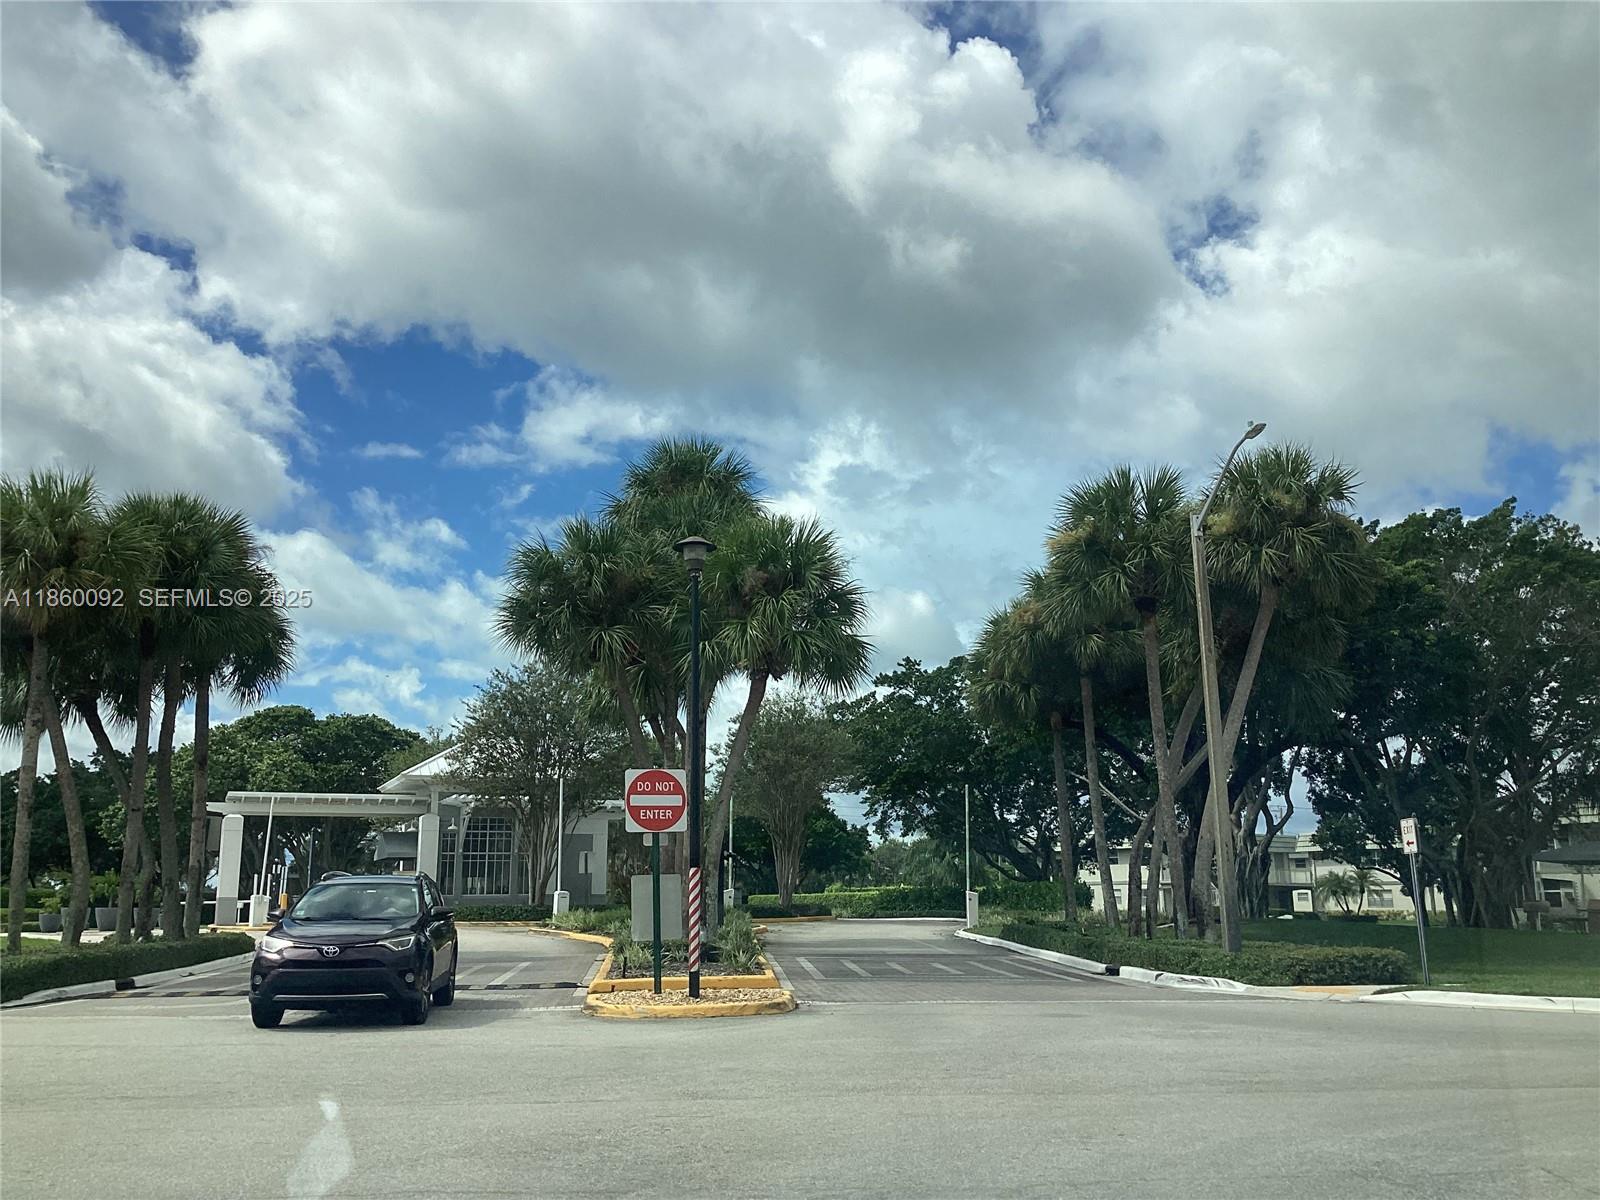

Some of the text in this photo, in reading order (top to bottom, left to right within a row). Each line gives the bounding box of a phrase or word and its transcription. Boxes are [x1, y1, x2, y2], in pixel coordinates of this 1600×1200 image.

[637, 781, 675, 792] DO NOT
[640, 809, 673, 820] ENTER
[1403, 825, 1413, 835] EXIT
